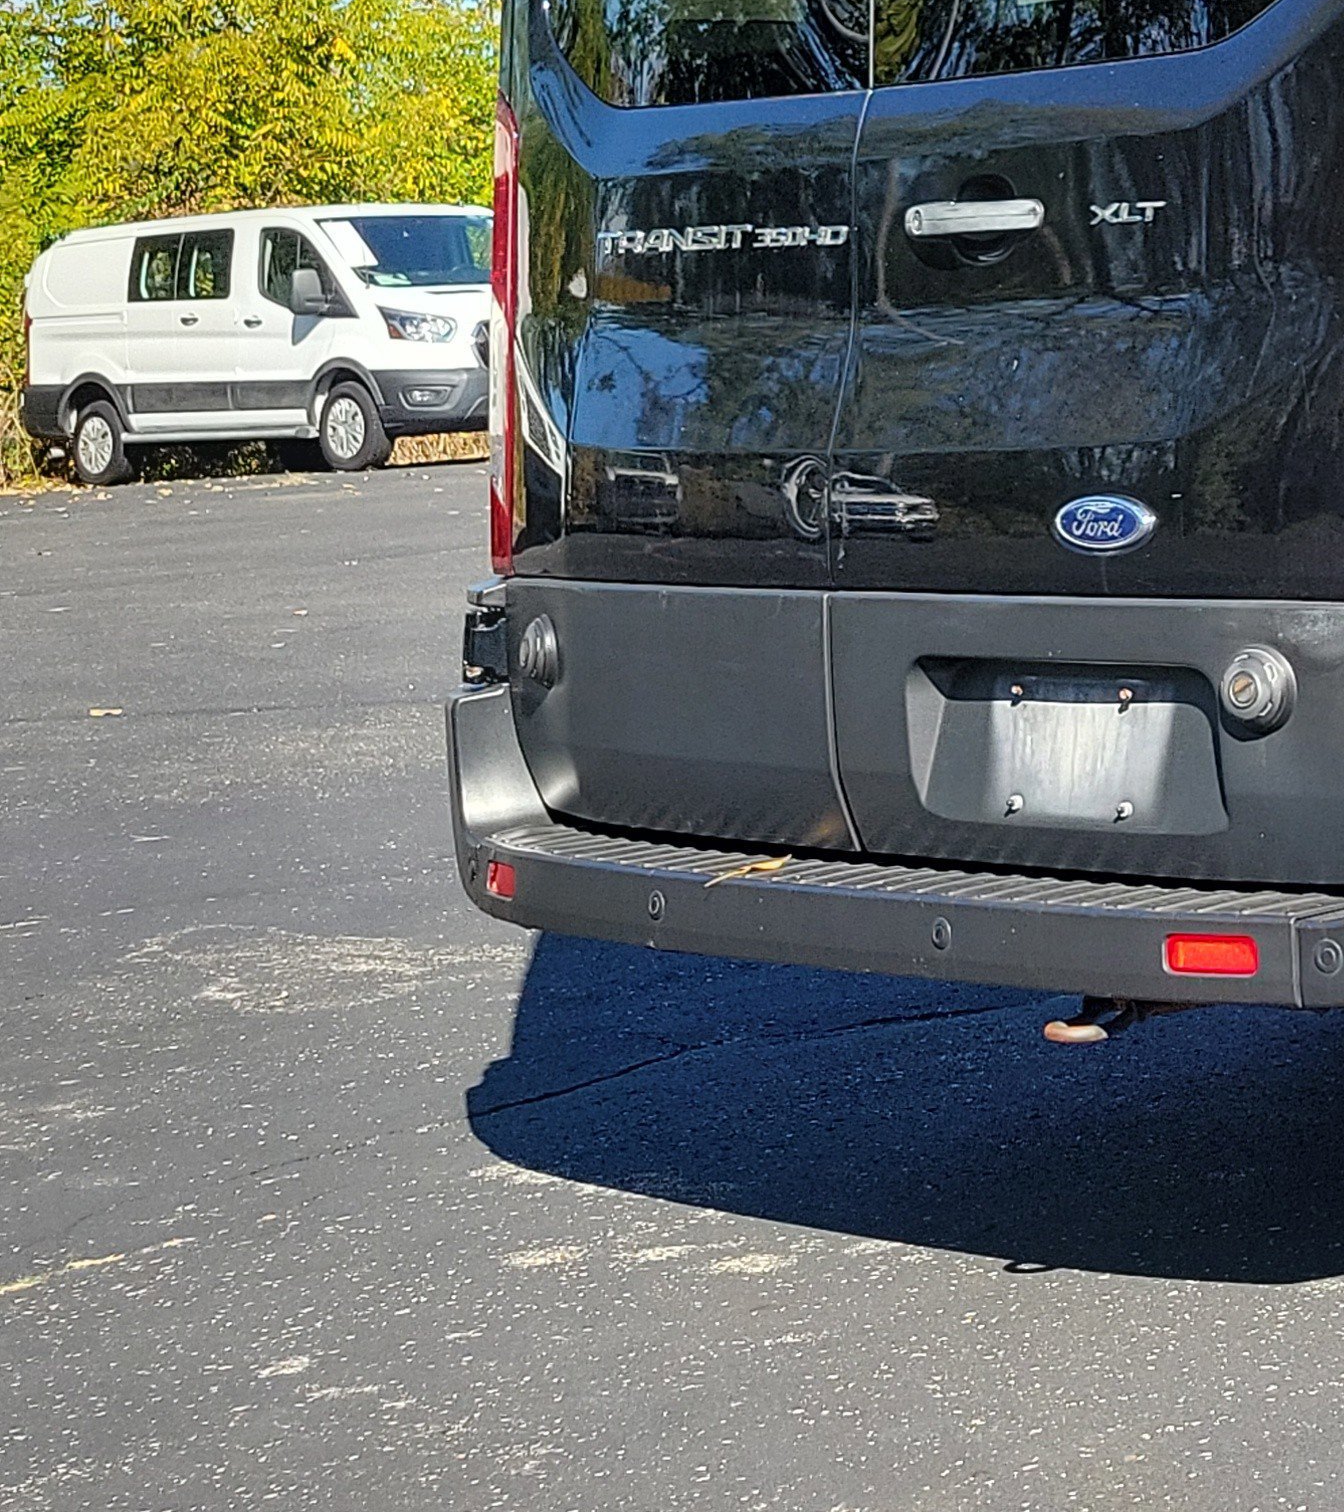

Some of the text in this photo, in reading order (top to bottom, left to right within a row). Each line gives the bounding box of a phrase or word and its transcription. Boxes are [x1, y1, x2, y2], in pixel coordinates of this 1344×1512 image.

[1089, 200, 1167, 225] XLT
[596, 223, 850, 254] TRANSIT 350HD
[1071, 501, 1124, 537] Ford
